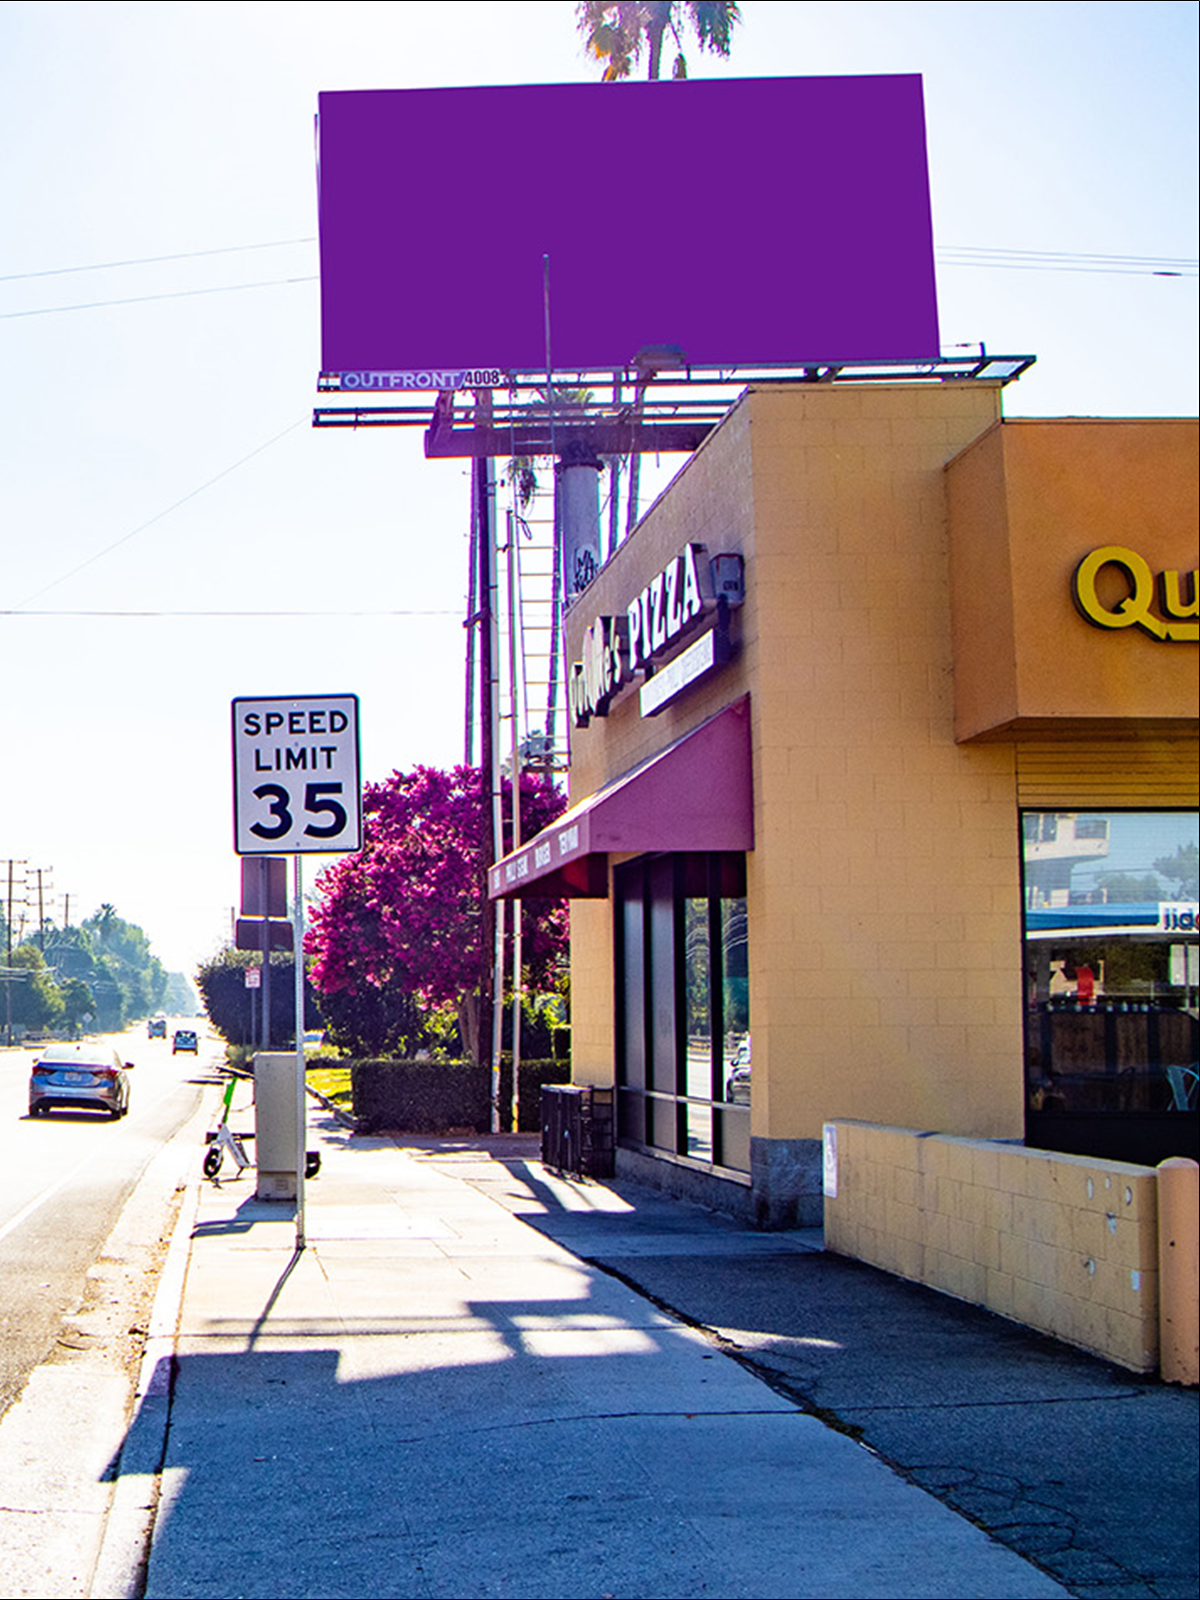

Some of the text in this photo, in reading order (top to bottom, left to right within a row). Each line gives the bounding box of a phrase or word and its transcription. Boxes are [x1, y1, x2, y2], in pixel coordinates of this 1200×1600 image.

[464, 369, 500, 385] 4008
[626, 542, 702, 671] PIZZA
[243, 710, 349, 737] SPEED
[254, 746, 338, 772] LIMIT
[249, 781, 348, 841] 35
